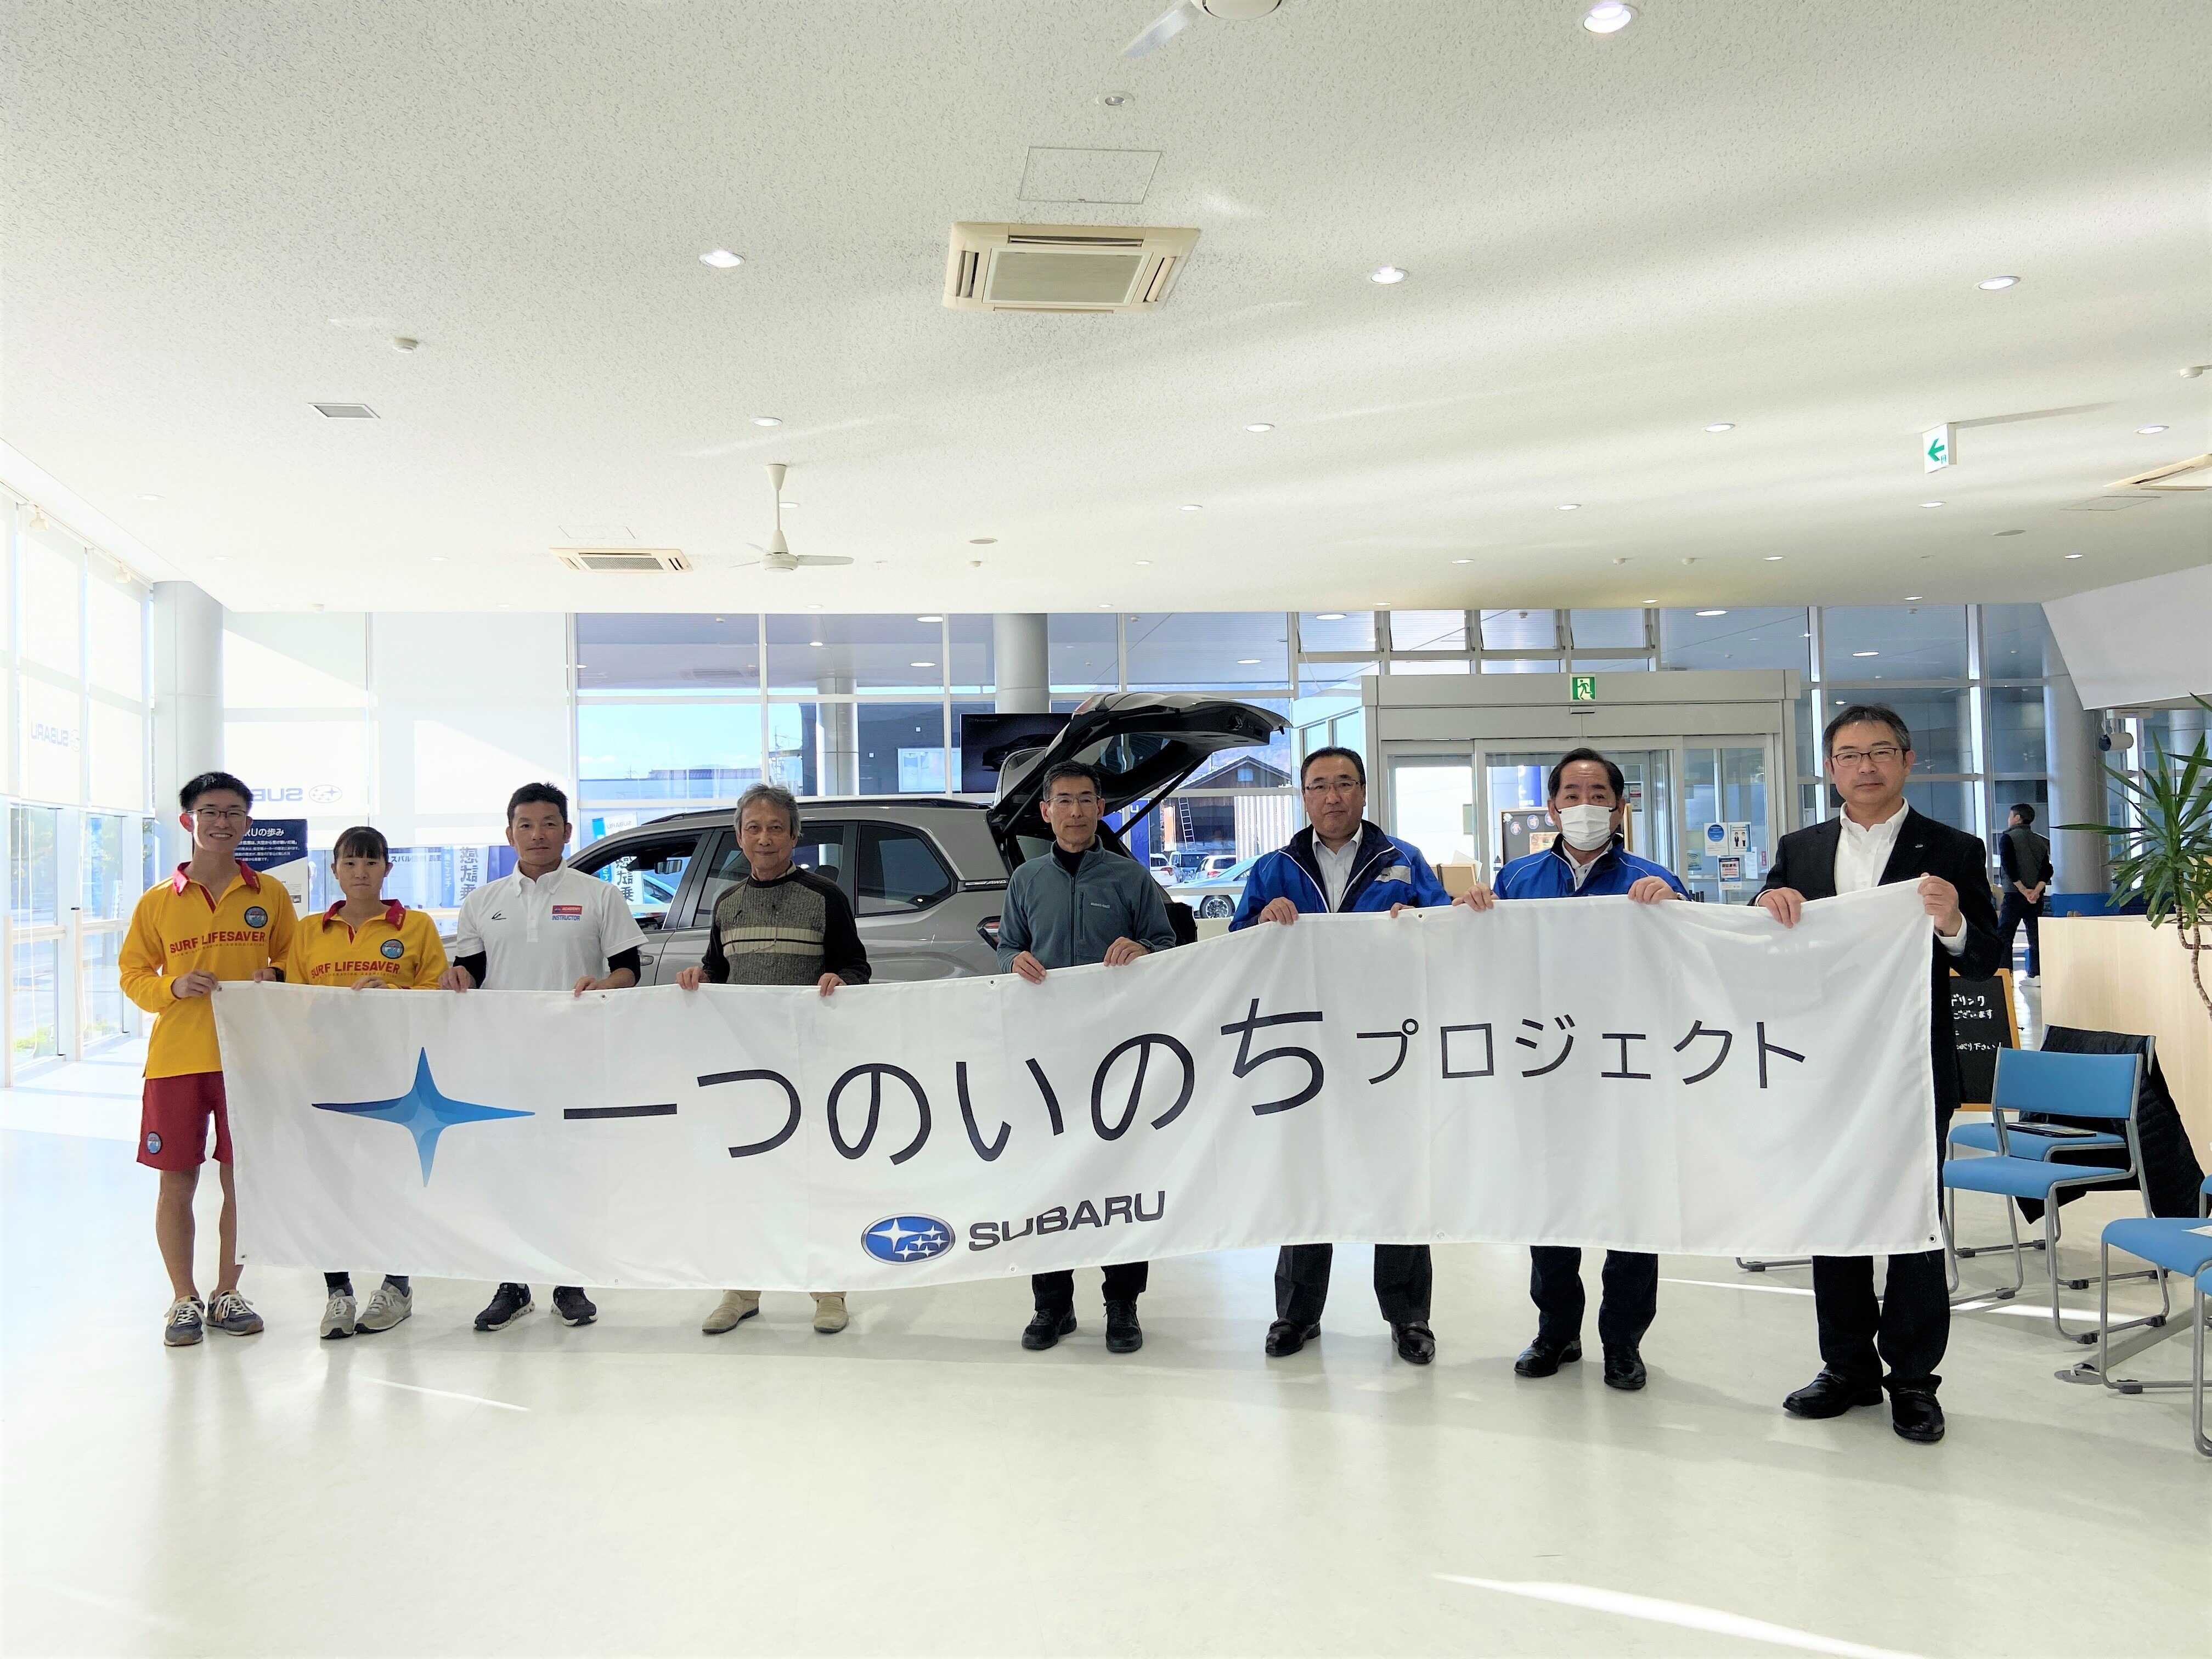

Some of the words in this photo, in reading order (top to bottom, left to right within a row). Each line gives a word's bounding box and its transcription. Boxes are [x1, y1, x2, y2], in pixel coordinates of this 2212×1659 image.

[242, 828, 285, 837] RUの歩み
[170, 938, 198, 953] SURF
[201, 931, 266, 945] LIFESAVER
[311, 963, 331, 979] SURF
[335, 961, 400, 974] LIFESAVER
[1954, 1009, 1993, 1019] ございます
[968, 1190, 1166, 1252] SUBARU
